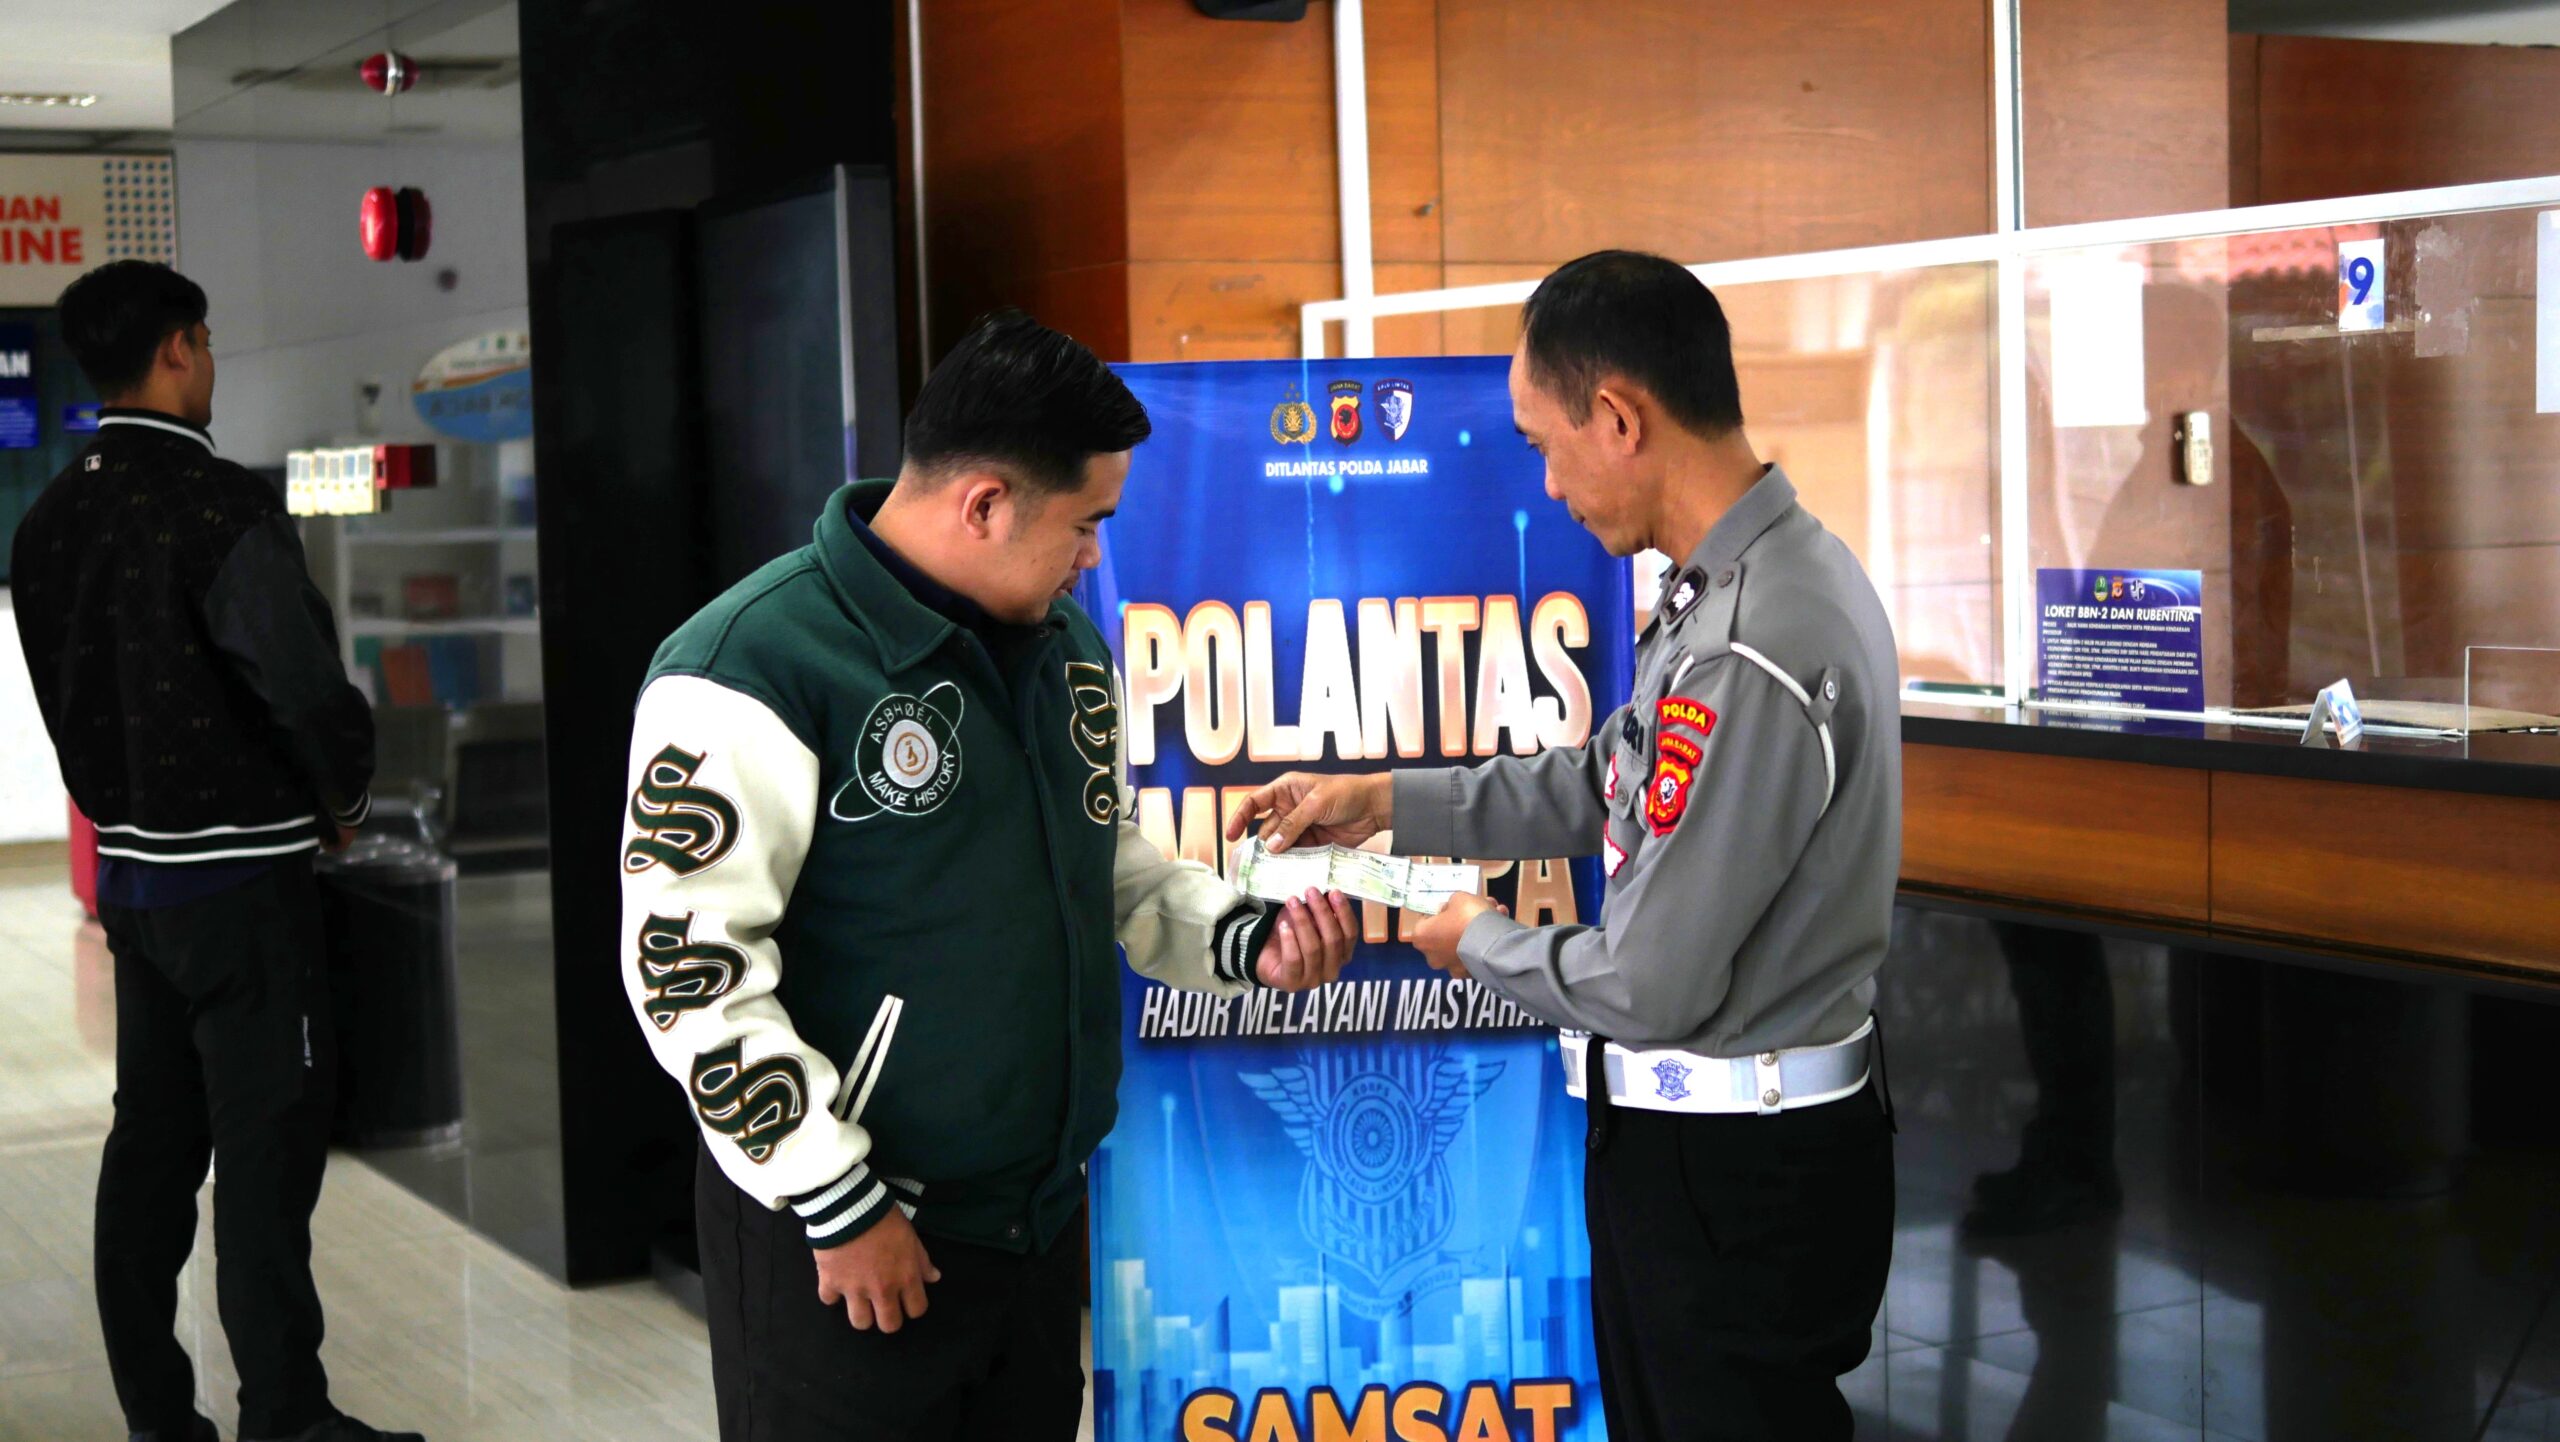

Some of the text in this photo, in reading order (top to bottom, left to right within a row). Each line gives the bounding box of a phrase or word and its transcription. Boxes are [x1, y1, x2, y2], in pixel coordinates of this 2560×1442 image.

[2348, 256, 2375, 306] 9
[1265, 459, 1429, 477] DITLANTAS POLDA JABAR
[2044, 605, 2195, 622] LOKET BBN-2 DAN RUBENTINA
[1123, 591, 1593, 766] POLANTAS
[1662, 703, 1706, 729] POLDA
[868, 750, 956, 808] MAKE HISTORY
[1139, 986, 1231, 1038] HADIR
[1237, 980, 1391, 1036] MELAYANI
[1181, 1381, 1575, 1442] SAMSAT
